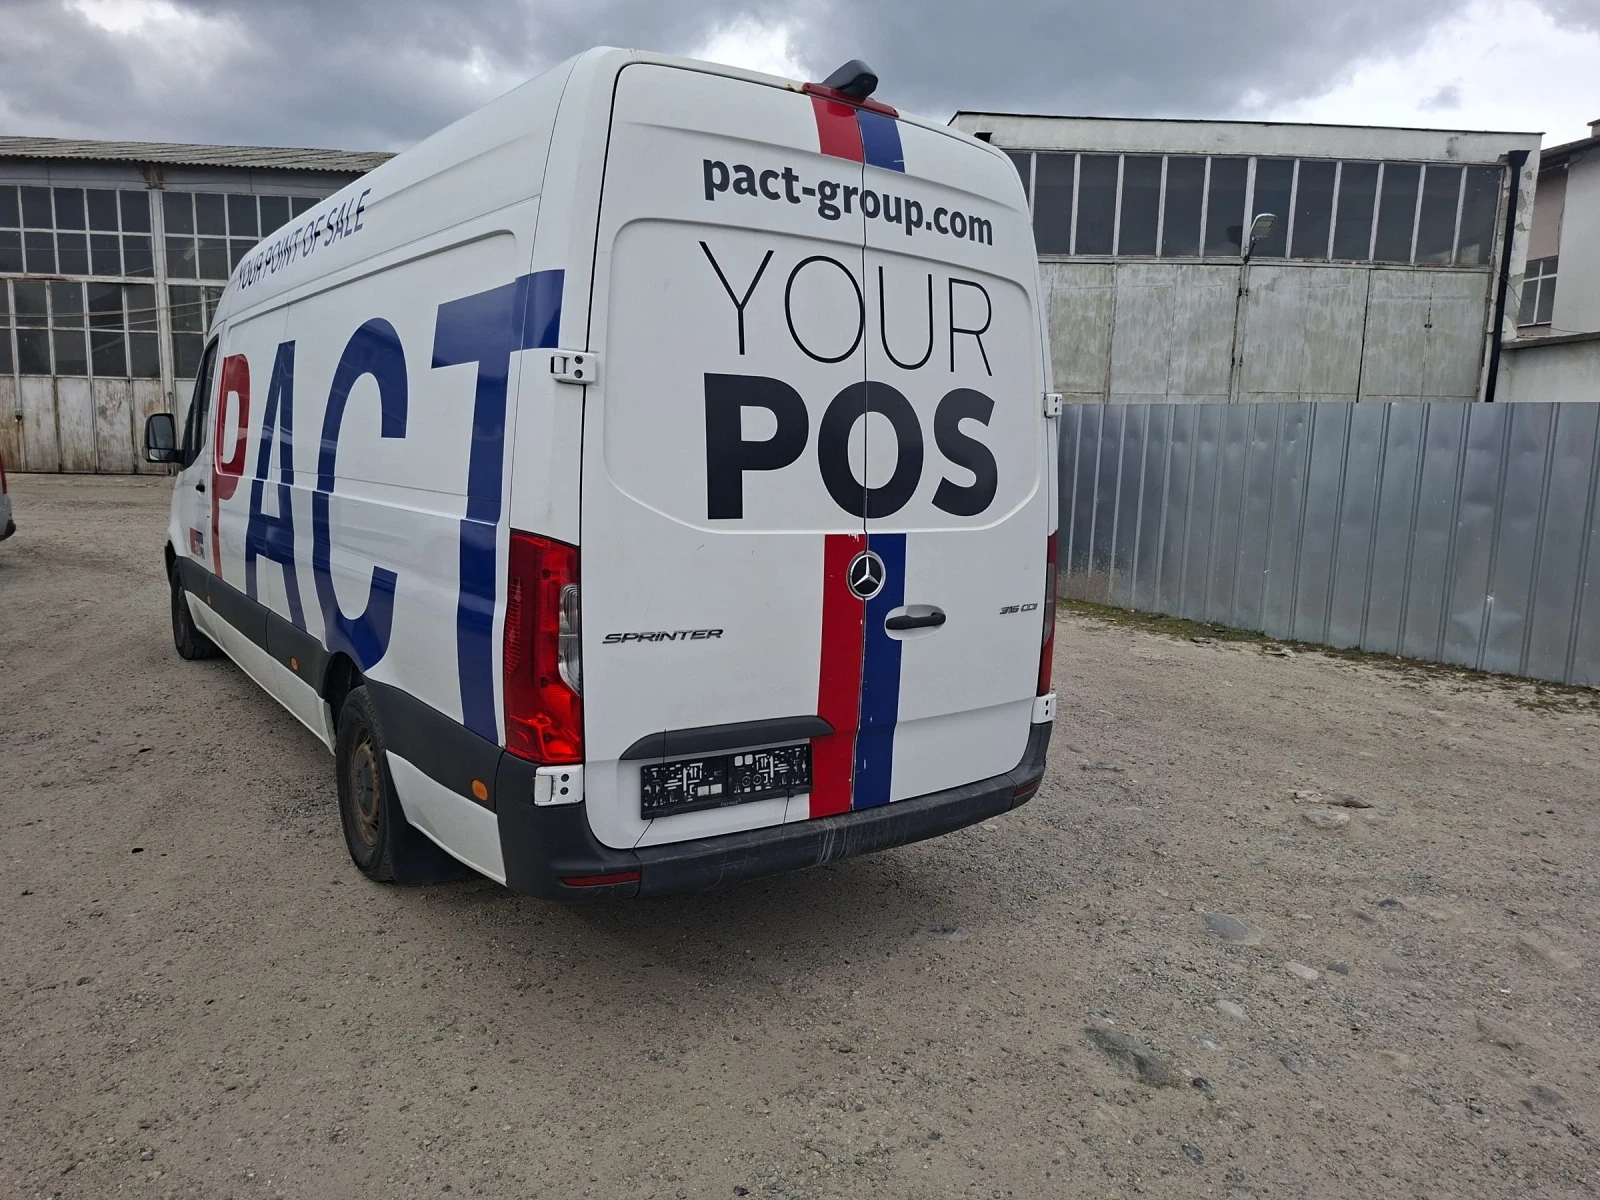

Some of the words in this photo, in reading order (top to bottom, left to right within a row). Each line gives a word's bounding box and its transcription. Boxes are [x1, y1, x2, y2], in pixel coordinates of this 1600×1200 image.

[237, 251, 264, 292] YOUR
[262, 227, 303, 278] POINT
[302, 214, 326, 258] OF
[324, 188, 372, 247] SALE
[702, 158, 993, 246] pact-group.com
[698, 240, 993, 376] YOUR
[703, 372, 998, 519] POS
[212, 268, 565, 746] PACT
[602, 629, 724, 644] SPRINTER
